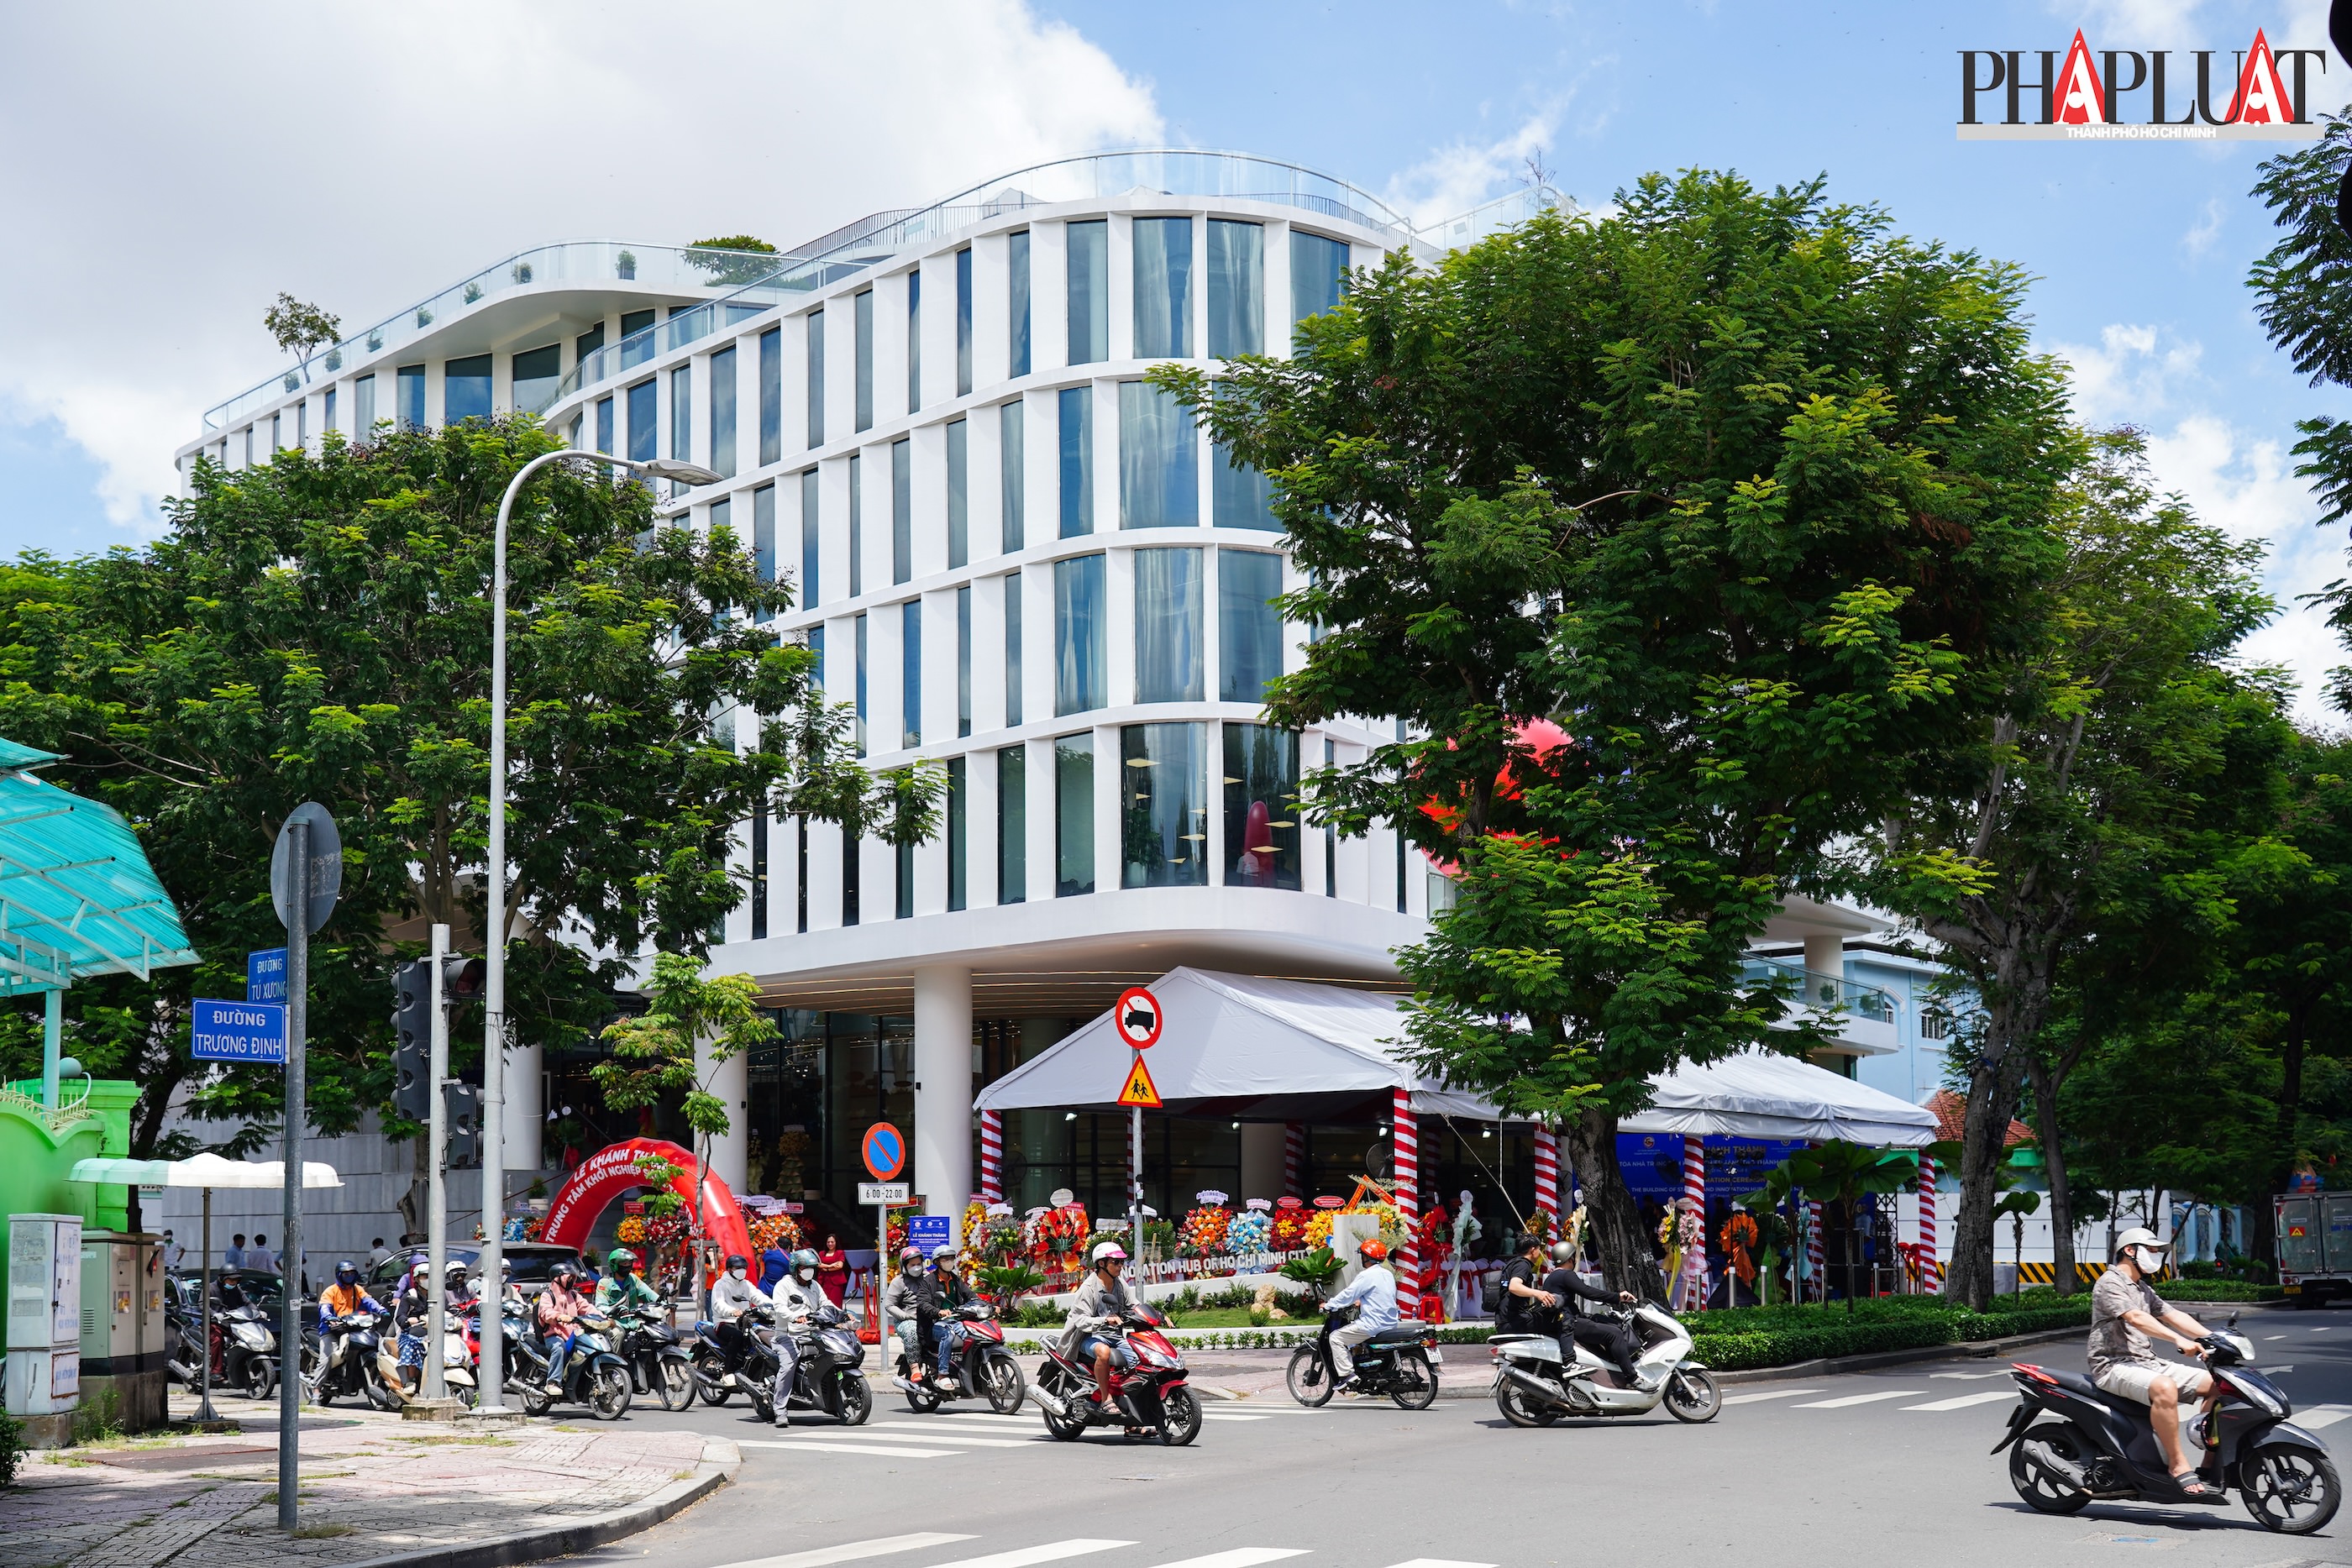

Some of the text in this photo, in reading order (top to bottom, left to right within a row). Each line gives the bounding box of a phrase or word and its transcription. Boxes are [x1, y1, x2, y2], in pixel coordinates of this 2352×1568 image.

[257, 957, 283, 974] ĐƯỜNG
[251, 980, 261, 1000] TÚ
[213, 1009, 265, 1026] ĐƯỜNG
[196, 1034, 281, 1058] TRƯƠNG ĐỊNH
[574, 1164, 586, 1183] LỄ
[590, 1149, 630, 1171] KHÁNH
[545, 1204, 570, 1243] TRUNG
[566, 1183, 588, 1205] TÂM
[585, 1167, 608, 1188] KHỞI
[608, 1162, 641, 1177] NGHIỆP
[1044, 1271, 1080, 1287] ARTUP
[1179, 1258, 1202, 1273] HUB
[1236, 1253, 1257, 1267] CHI
[1257, 1251, 1286, 1265] MINH
